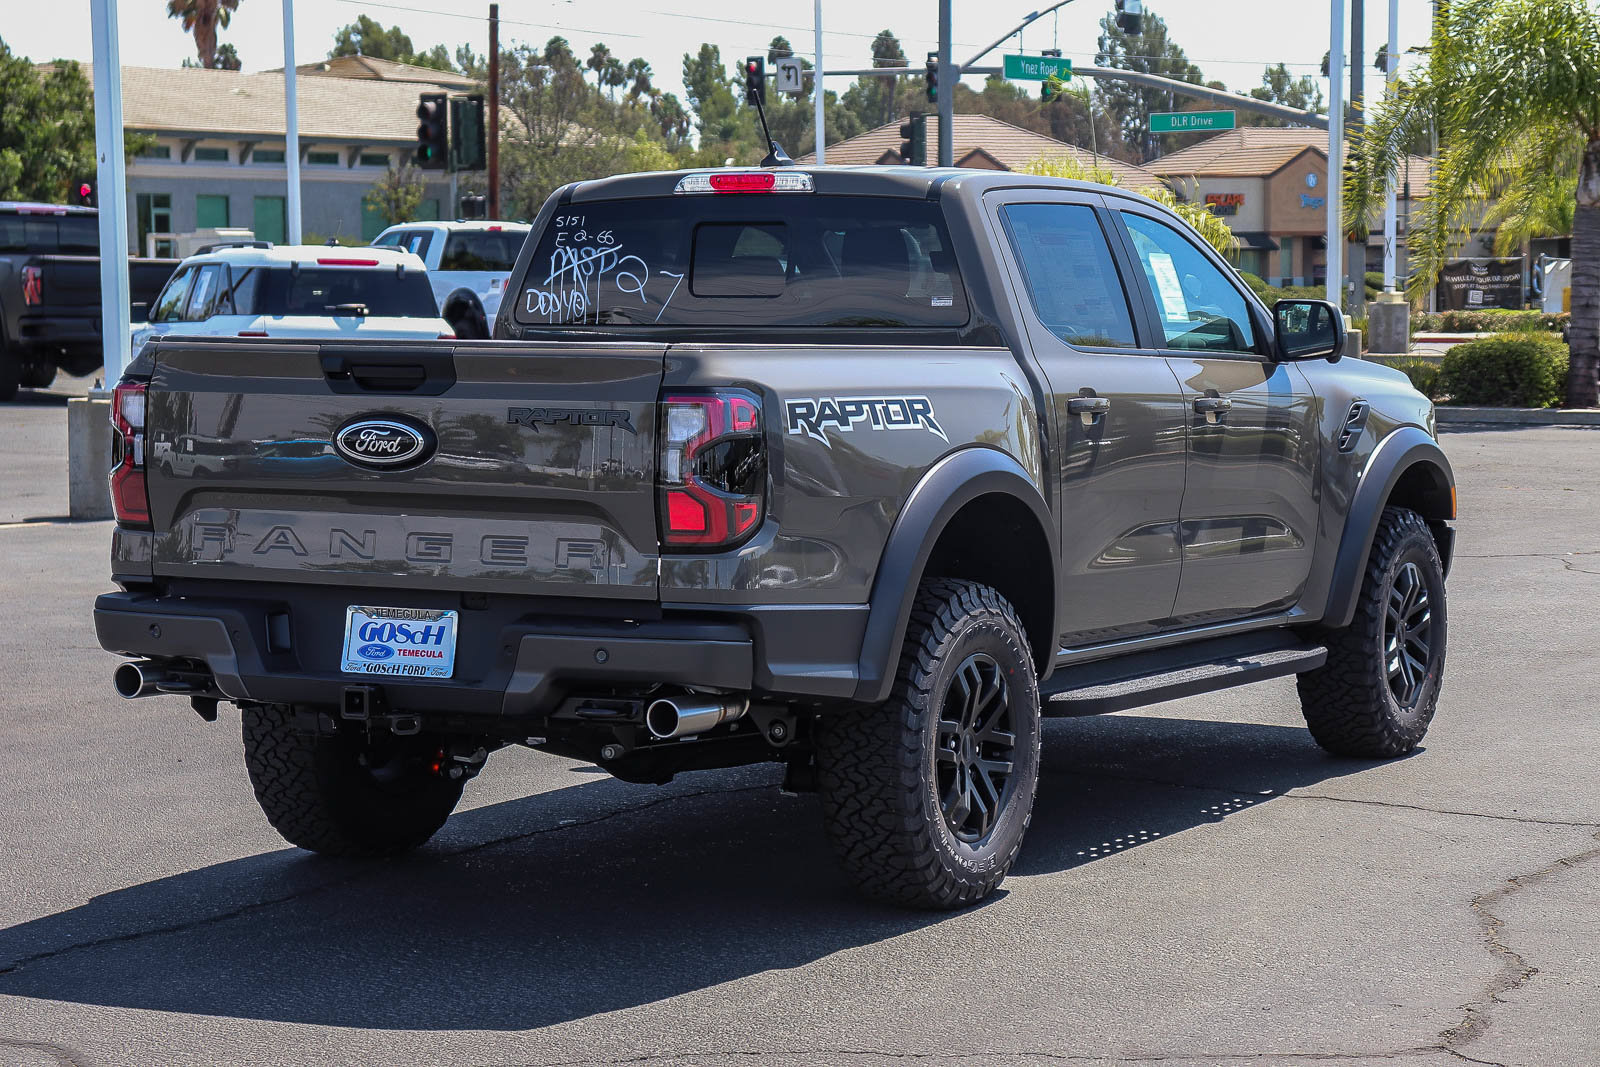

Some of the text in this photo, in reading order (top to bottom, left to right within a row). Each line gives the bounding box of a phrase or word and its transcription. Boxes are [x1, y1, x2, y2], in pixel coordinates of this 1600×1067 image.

[1021, 61, 1058, 76] Ynez Road
[1171, 115, 1213, 127] DLR Drive
[507, 407, 638, 436] RAPTOR
[785, 395, 951, 450] RAPTOR
[355, 429, 402, 453] Ford
[192, 523, 608, 570] RANGER
[374, 607, 431, 620] TEMECULA
[365, 646, 443, 659] Ford TEMECULA
